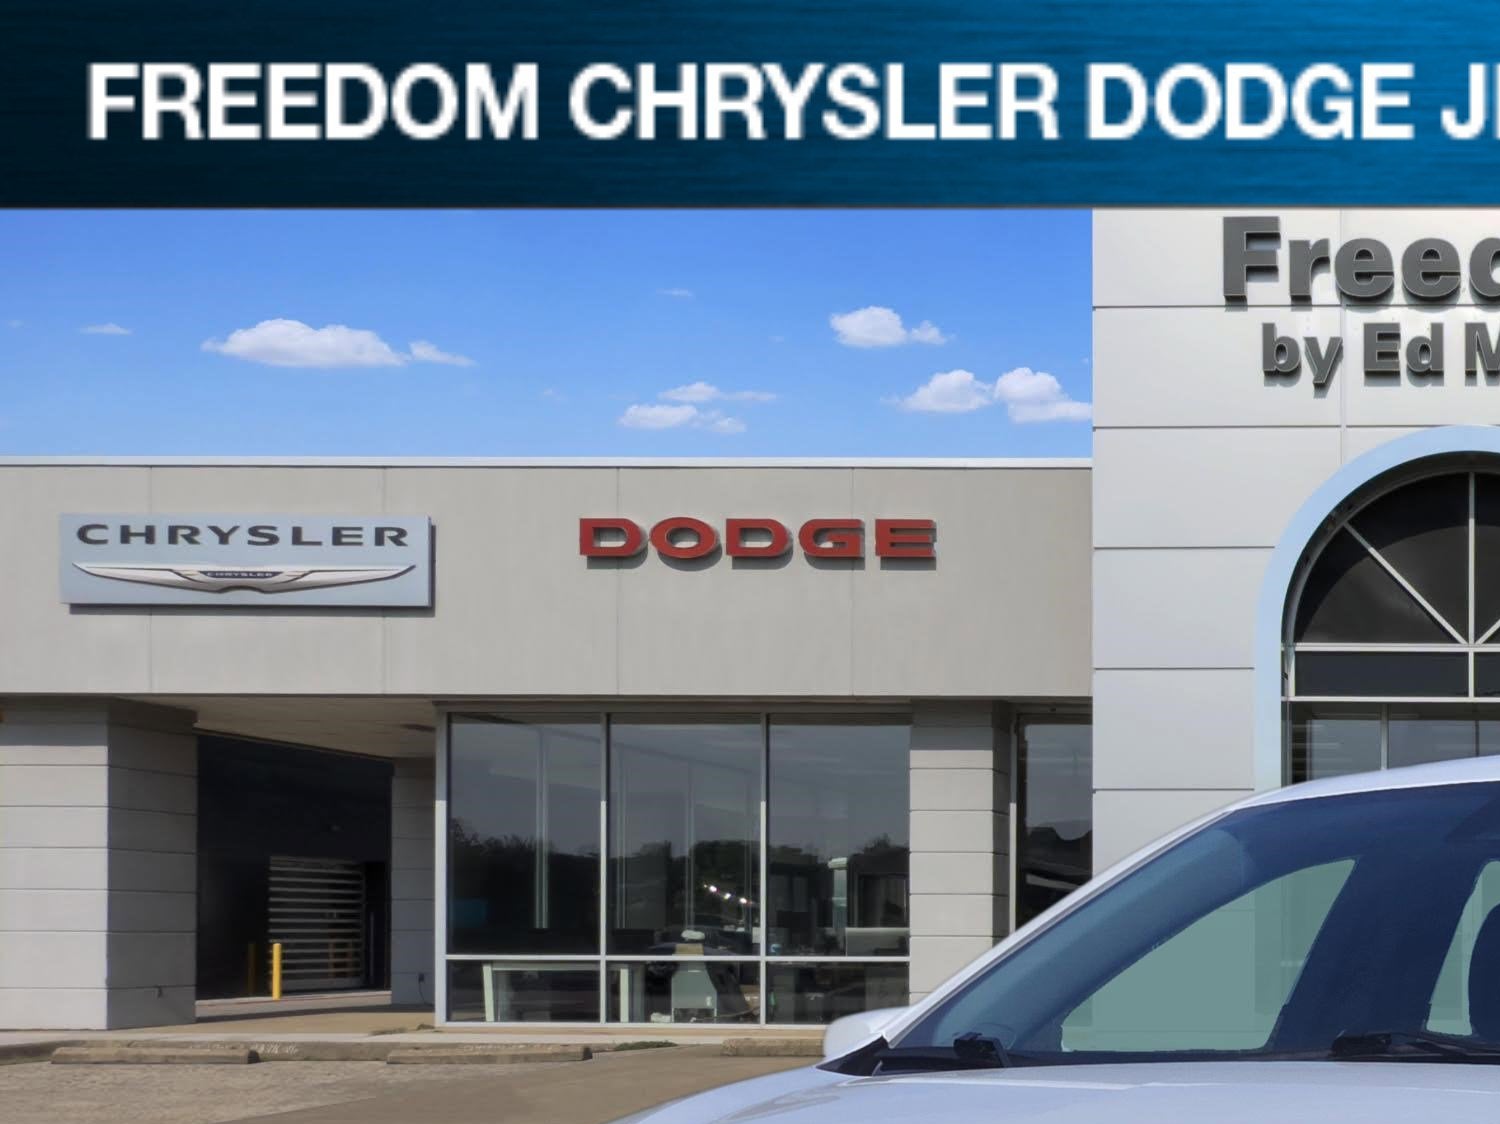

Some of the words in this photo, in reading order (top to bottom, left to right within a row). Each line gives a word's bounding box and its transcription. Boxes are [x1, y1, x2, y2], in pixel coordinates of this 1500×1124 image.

[1262, 322, 1343, 389] by
[1363, 322, 1445, 376] Ed
[76, 523, 409, 547] CHRYSLER
[579, 517, 936, 560] DODGE
